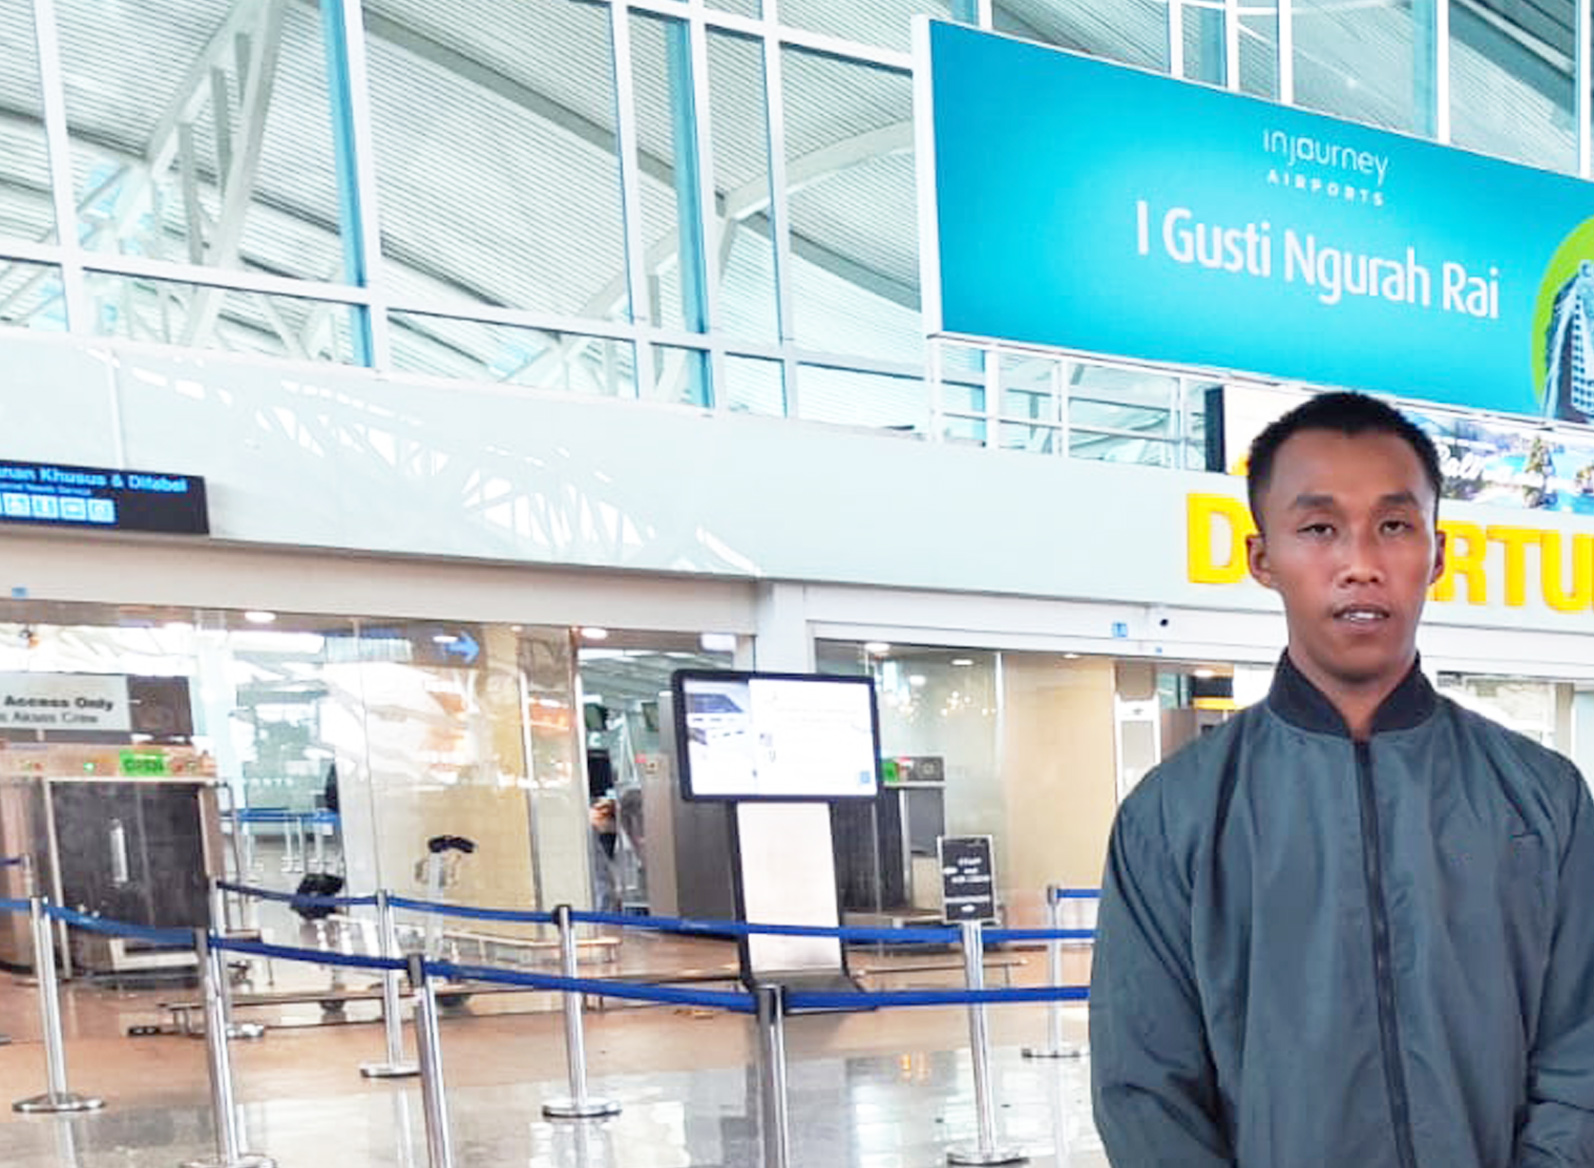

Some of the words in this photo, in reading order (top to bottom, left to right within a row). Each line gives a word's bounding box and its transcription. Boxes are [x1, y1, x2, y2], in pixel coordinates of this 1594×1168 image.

[1263, 129, 1388, 185] injourney
[1267, 169, 1384, 206] AIRPORTS
[1137, 200, 1149, 255] I
[1162, 207, 1271, 278] Gusti
[1284, 229, 1430, 305] Ngurah
[1442, 262, 1499, 318] Rai
[40, 468, 107, 487] Khusus
[5, 696, 69, 708] Access
[75, 697, 114, 711] Only
